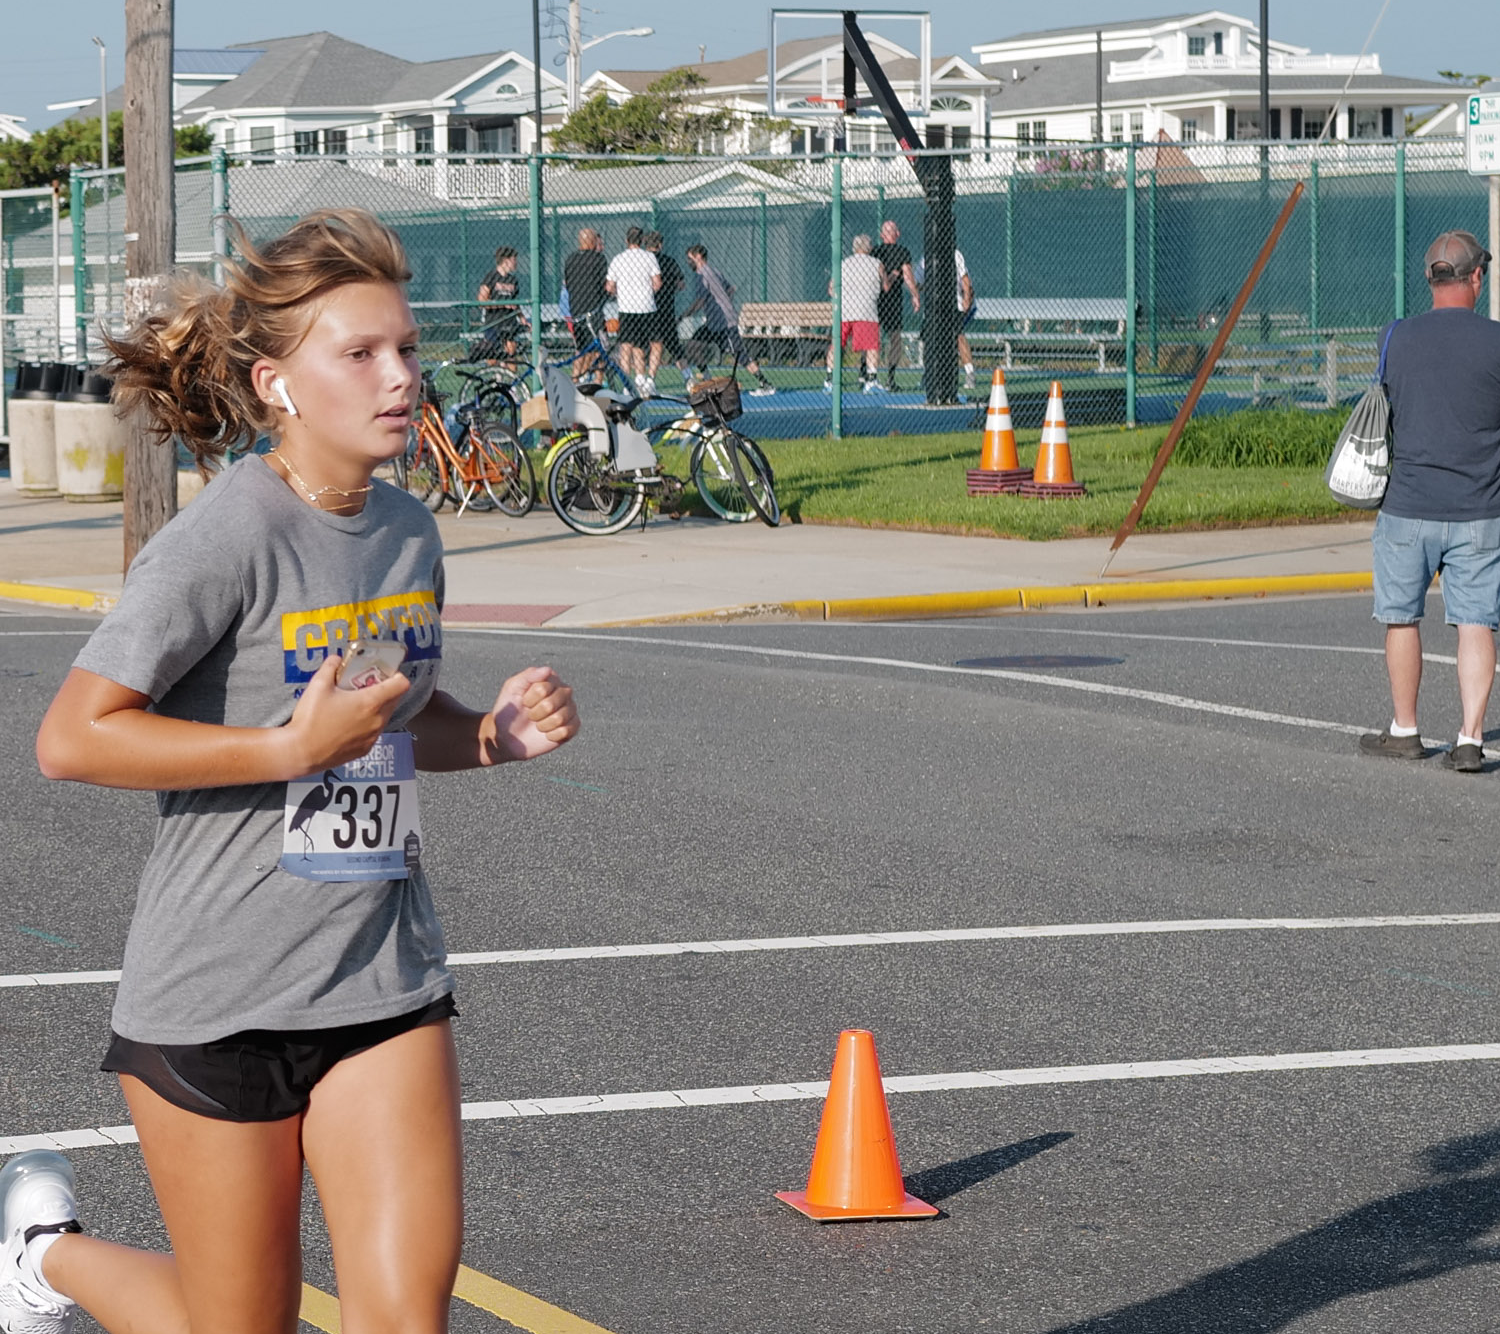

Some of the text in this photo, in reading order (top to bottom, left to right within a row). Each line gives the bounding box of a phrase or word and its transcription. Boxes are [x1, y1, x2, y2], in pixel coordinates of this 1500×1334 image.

[1470, 100, 1479, 122] 3
[1479, 150, 1495, 161] 9PM
[344, 760, 395, 779] HUSTLE
[333, 785, 400, 849] 337
